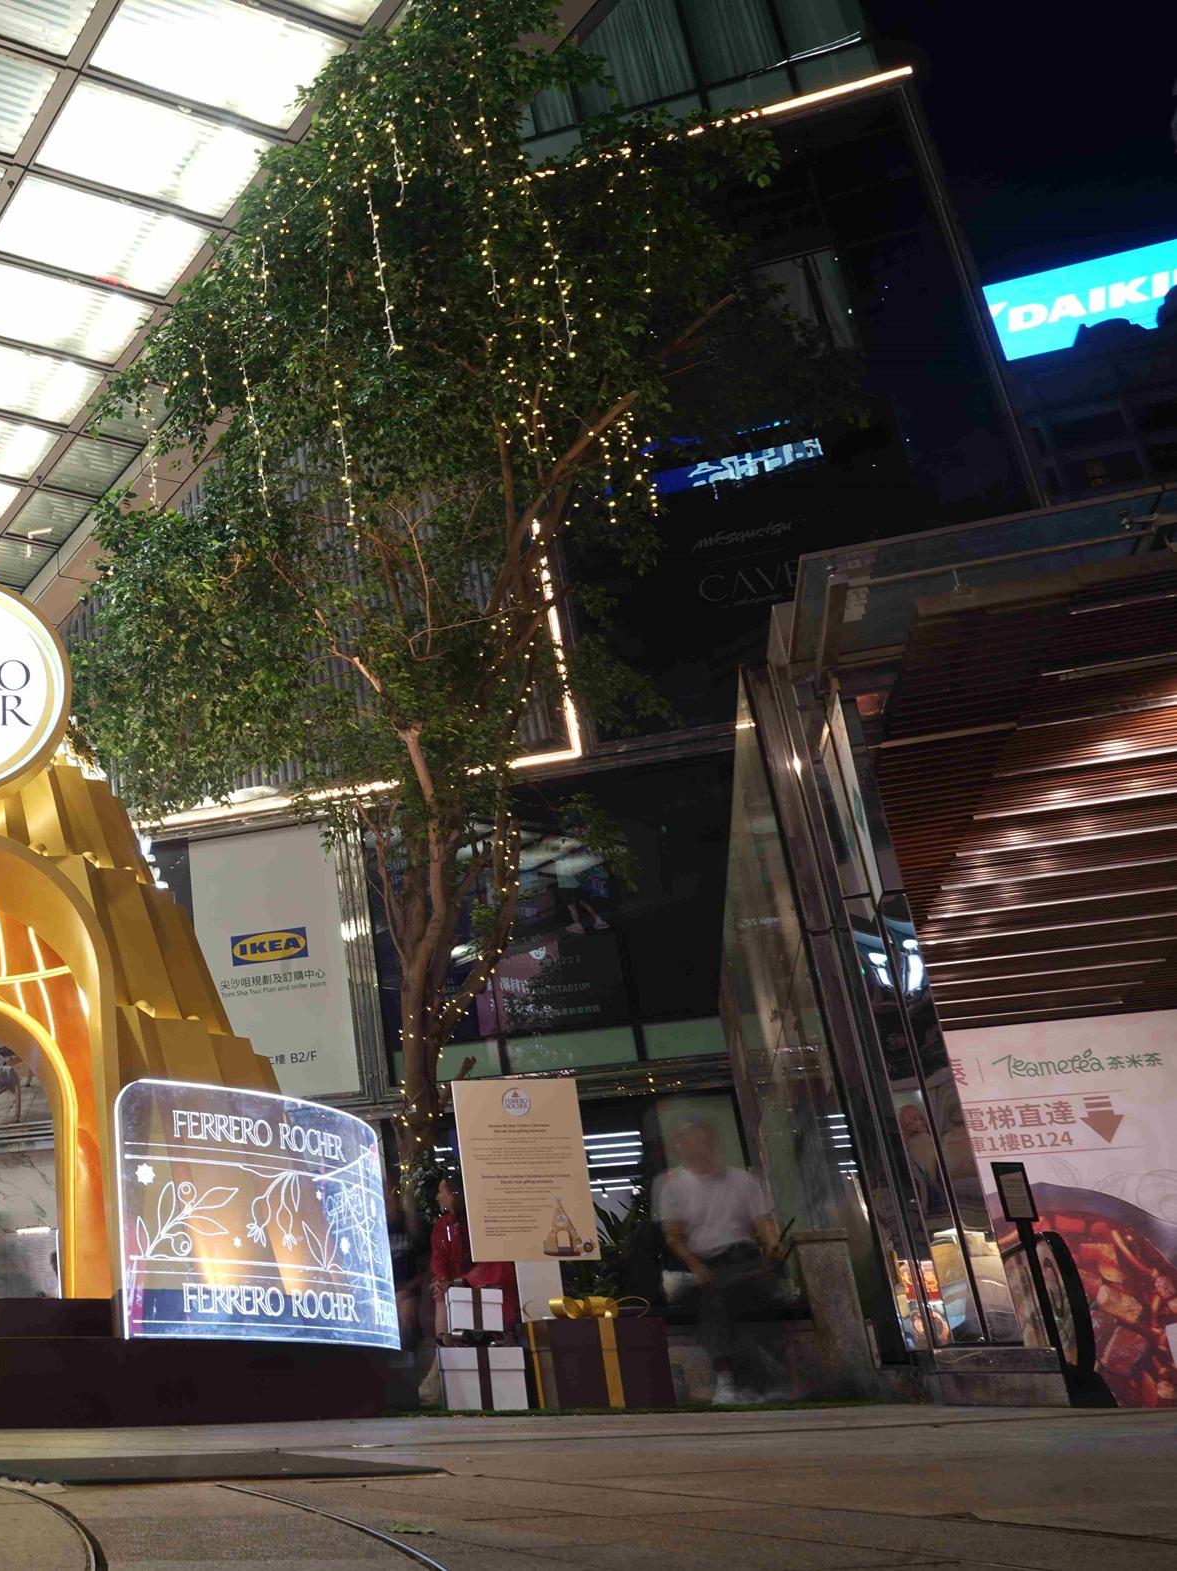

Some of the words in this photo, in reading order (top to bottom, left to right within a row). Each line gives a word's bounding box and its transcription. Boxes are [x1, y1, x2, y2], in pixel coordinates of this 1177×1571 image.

[239, 936, 301, 956] IKEA
[220, 968, 326, 990] 尖沙咀規劃及訂購中心
[236, 989, 248, 997] Sha
[291, 983, 308, 991] order
[309, 980, 326, 989] point
[290, 1050, 317, 1064] B2/F
[1106, 1051, 1163, 1071] 茶米茶
[962, 1100, 1076, 1132] 電梯直達
[173, 1109, 273, 1146] FERRERO
[279, 1122, 346, 1162] ROCHER
[183, 1283, 285, 1317] FERRERO
[292, 1291, 360, 1322] ROCHER
